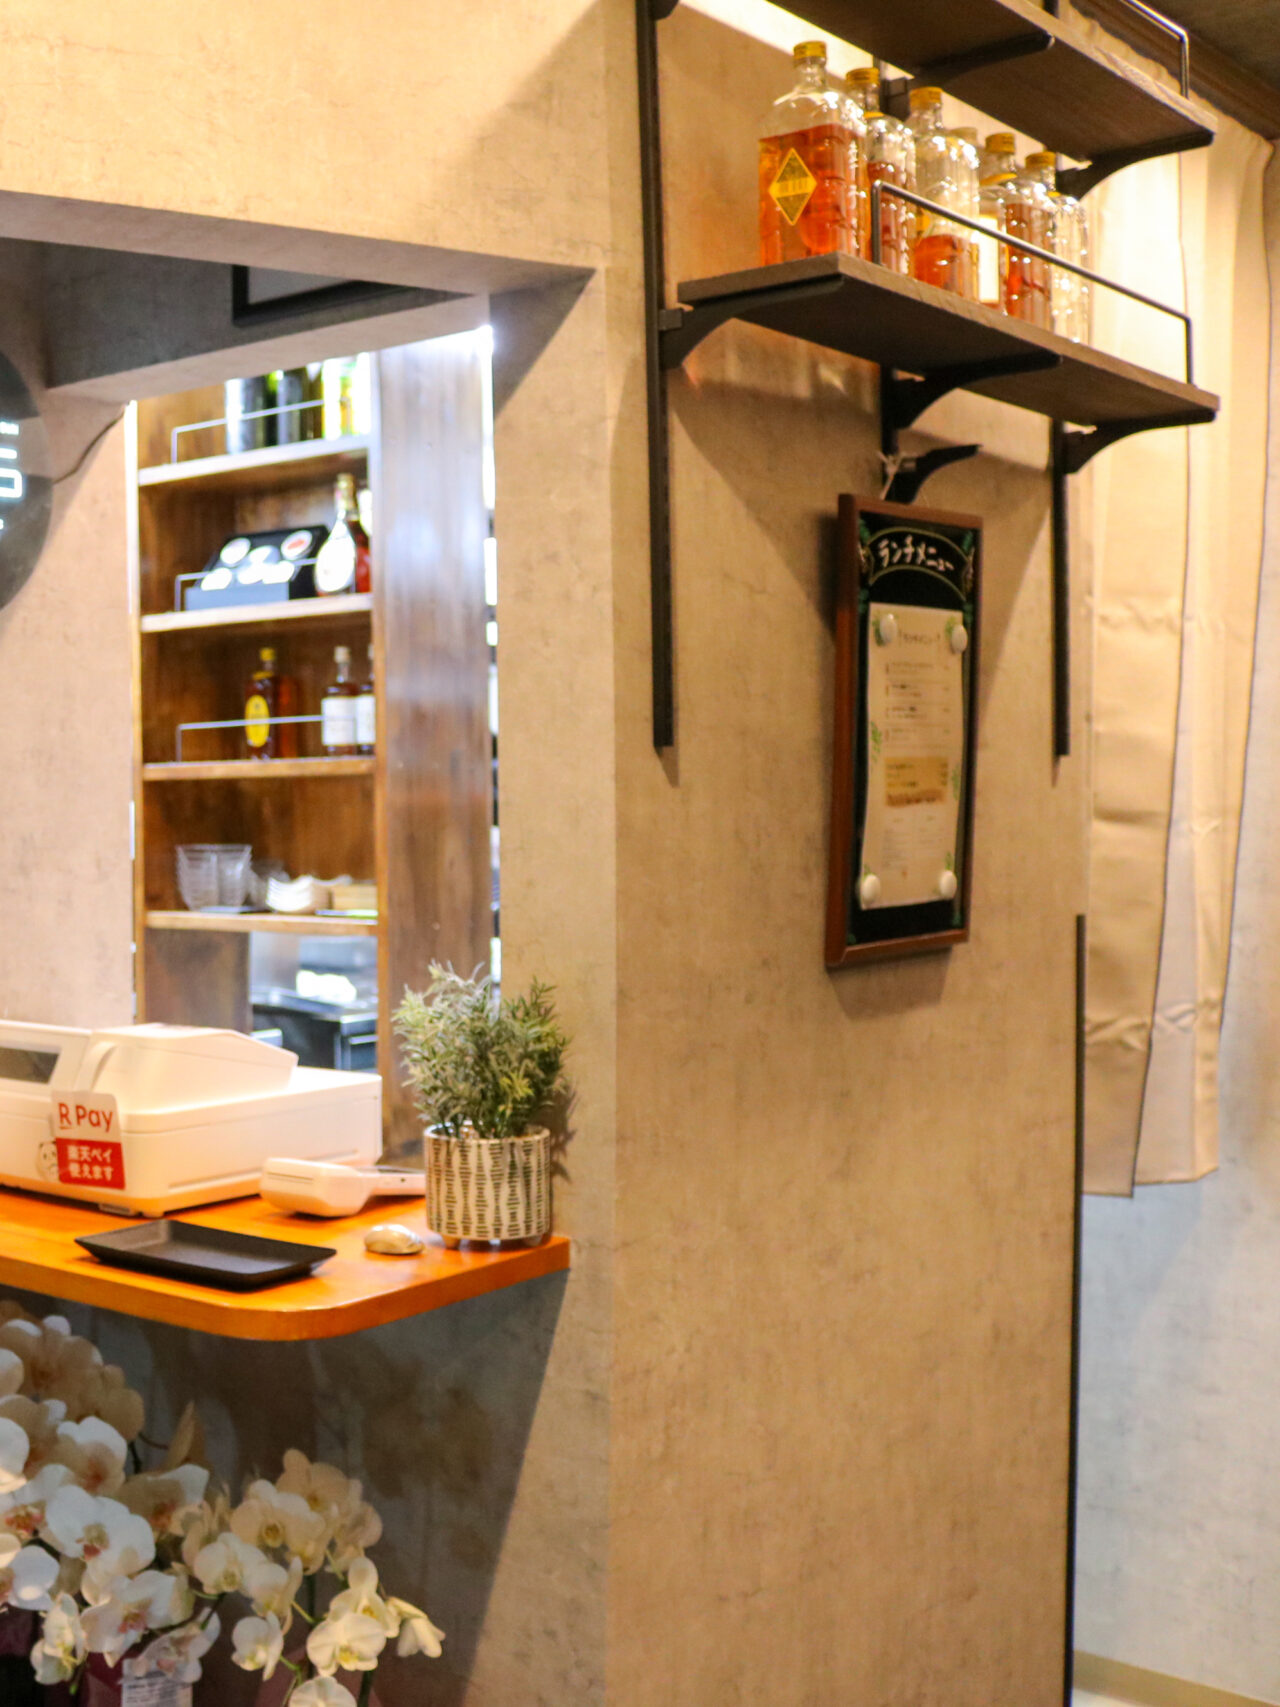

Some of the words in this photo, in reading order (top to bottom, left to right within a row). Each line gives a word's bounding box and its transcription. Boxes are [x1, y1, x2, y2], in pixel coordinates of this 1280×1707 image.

[879, 535, 955, 572] ランチメニュー
[58, 1102, 72, 1129] R
[75, 1104, 113, 1133] Pay
